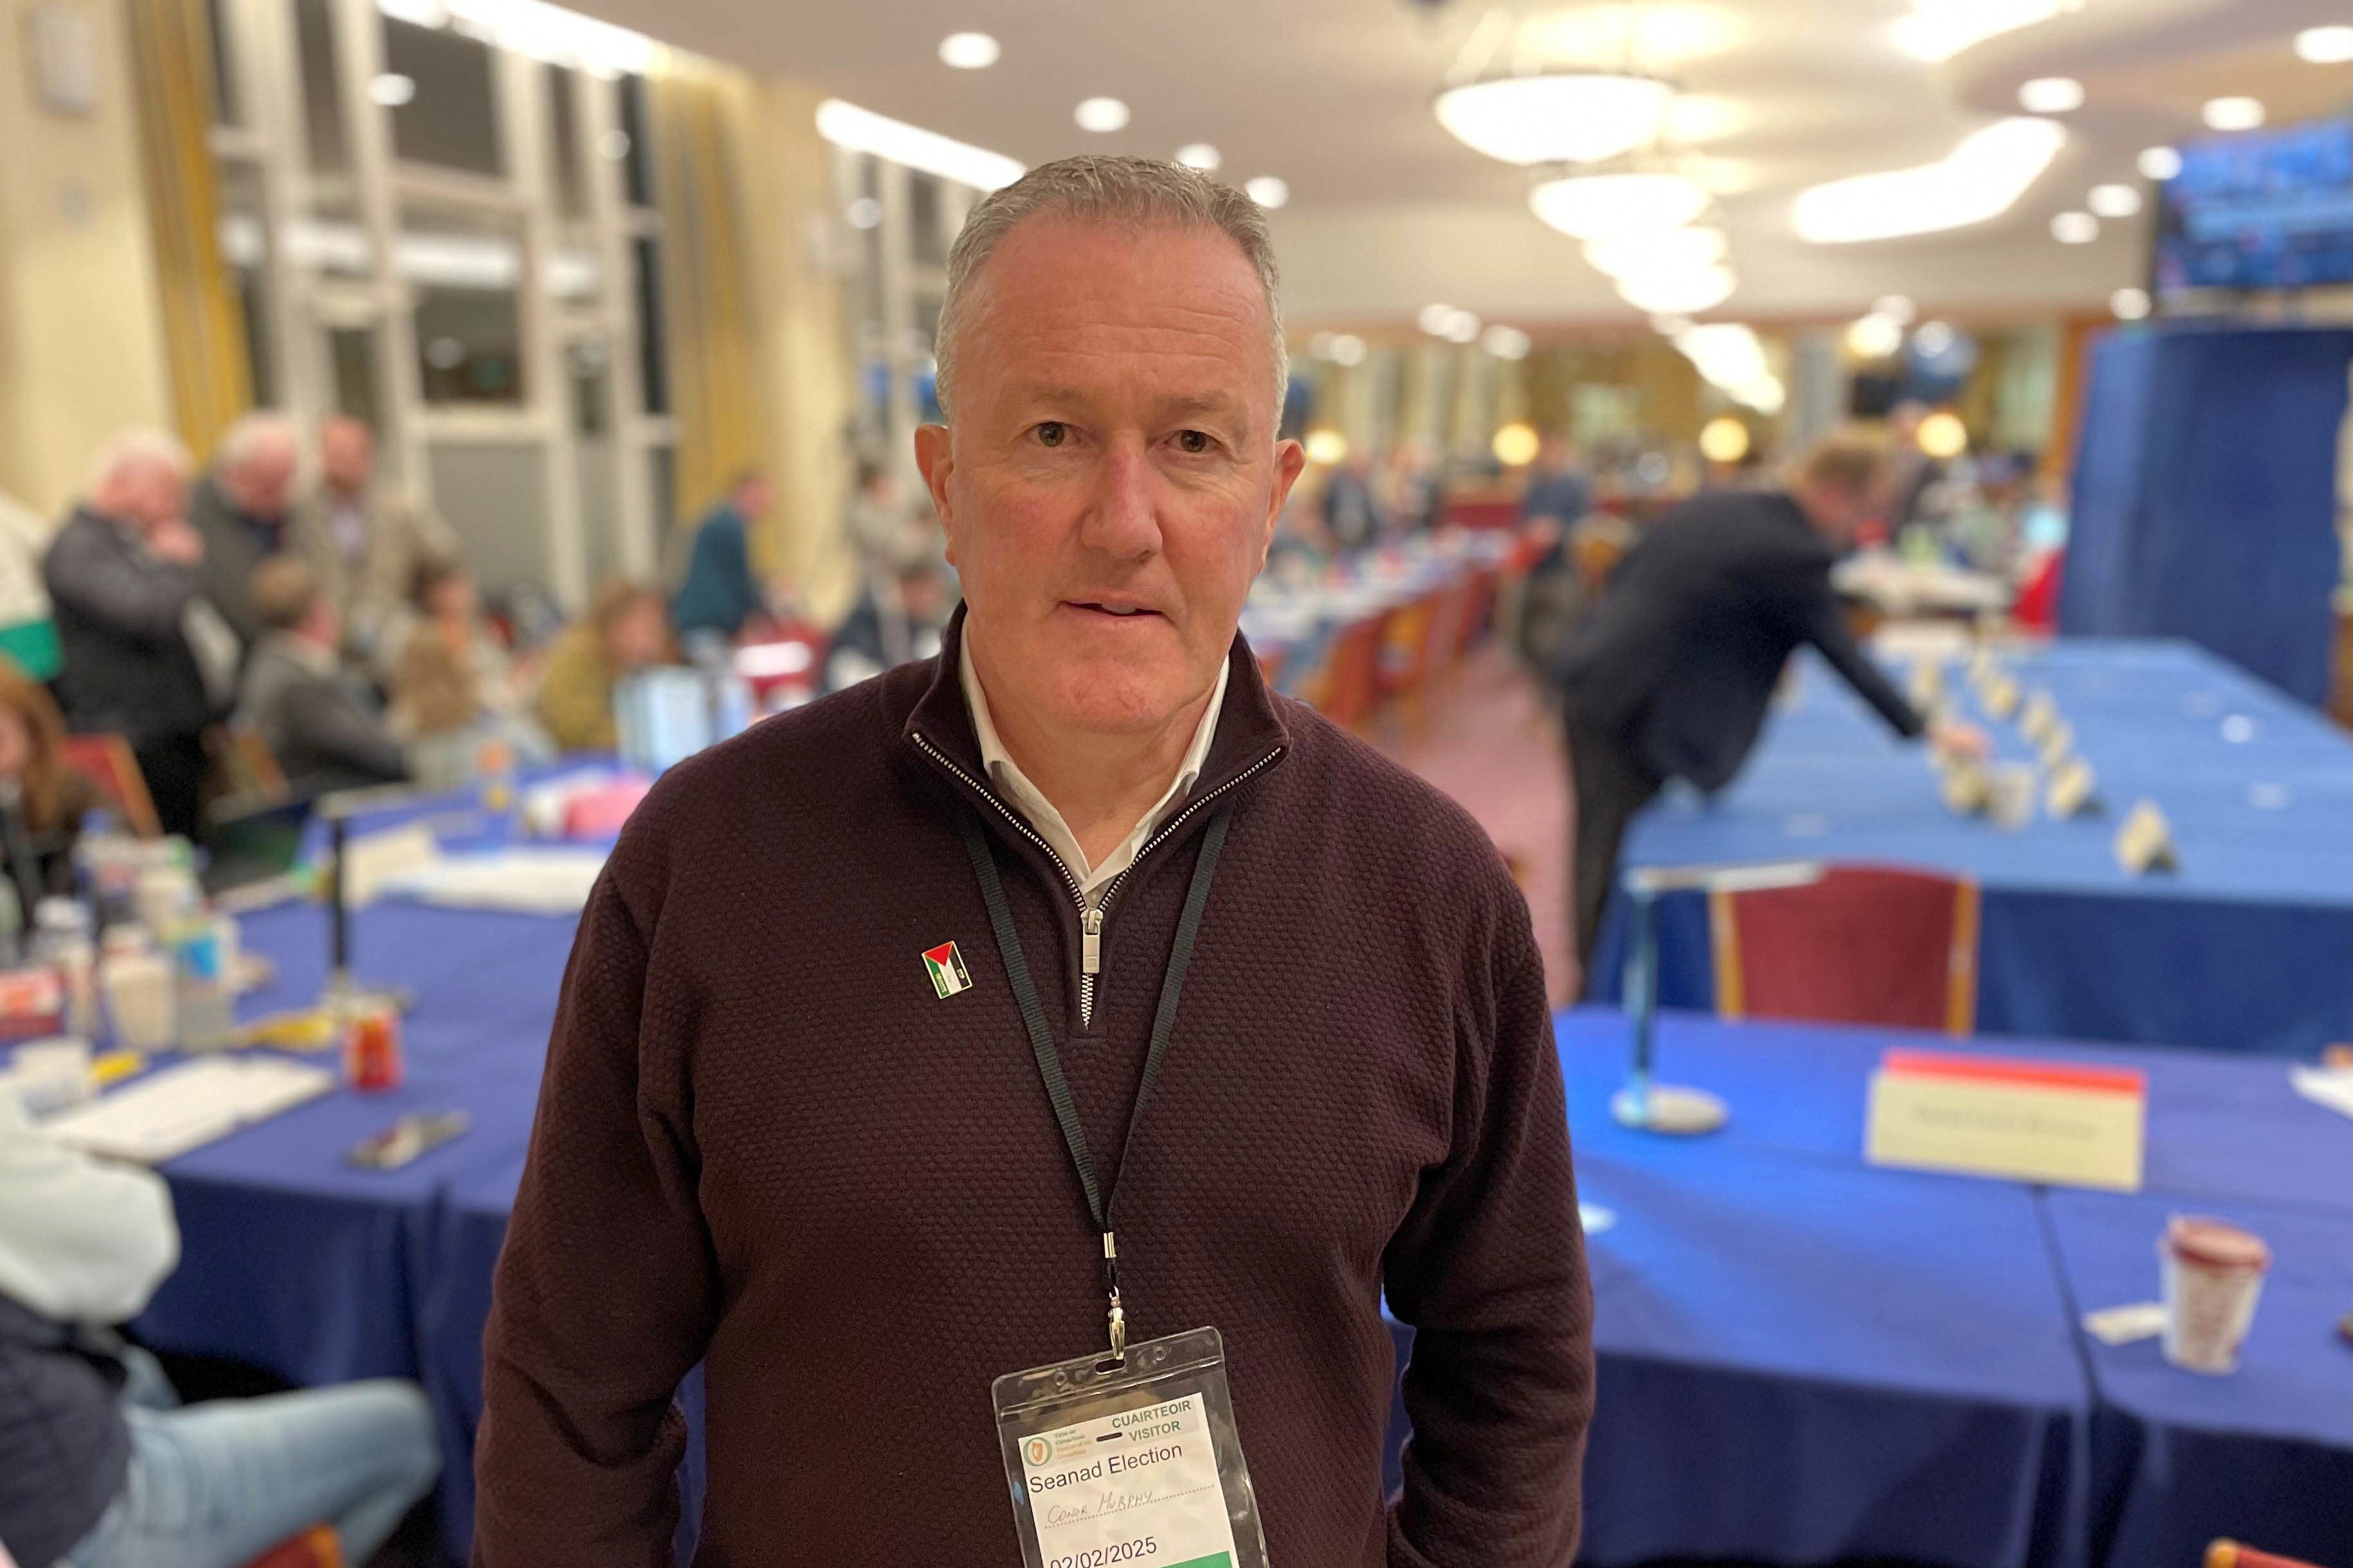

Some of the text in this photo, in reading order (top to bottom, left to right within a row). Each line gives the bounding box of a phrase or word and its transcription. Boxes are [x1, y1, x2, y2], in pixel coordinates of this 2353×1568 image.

[1112, 1400, 1192, 1428] CUAIRTEOIR
[1128, 1420, 1181, 1442] VISITOR
[1030, 1445, 1183, 1493] Seanad Election
